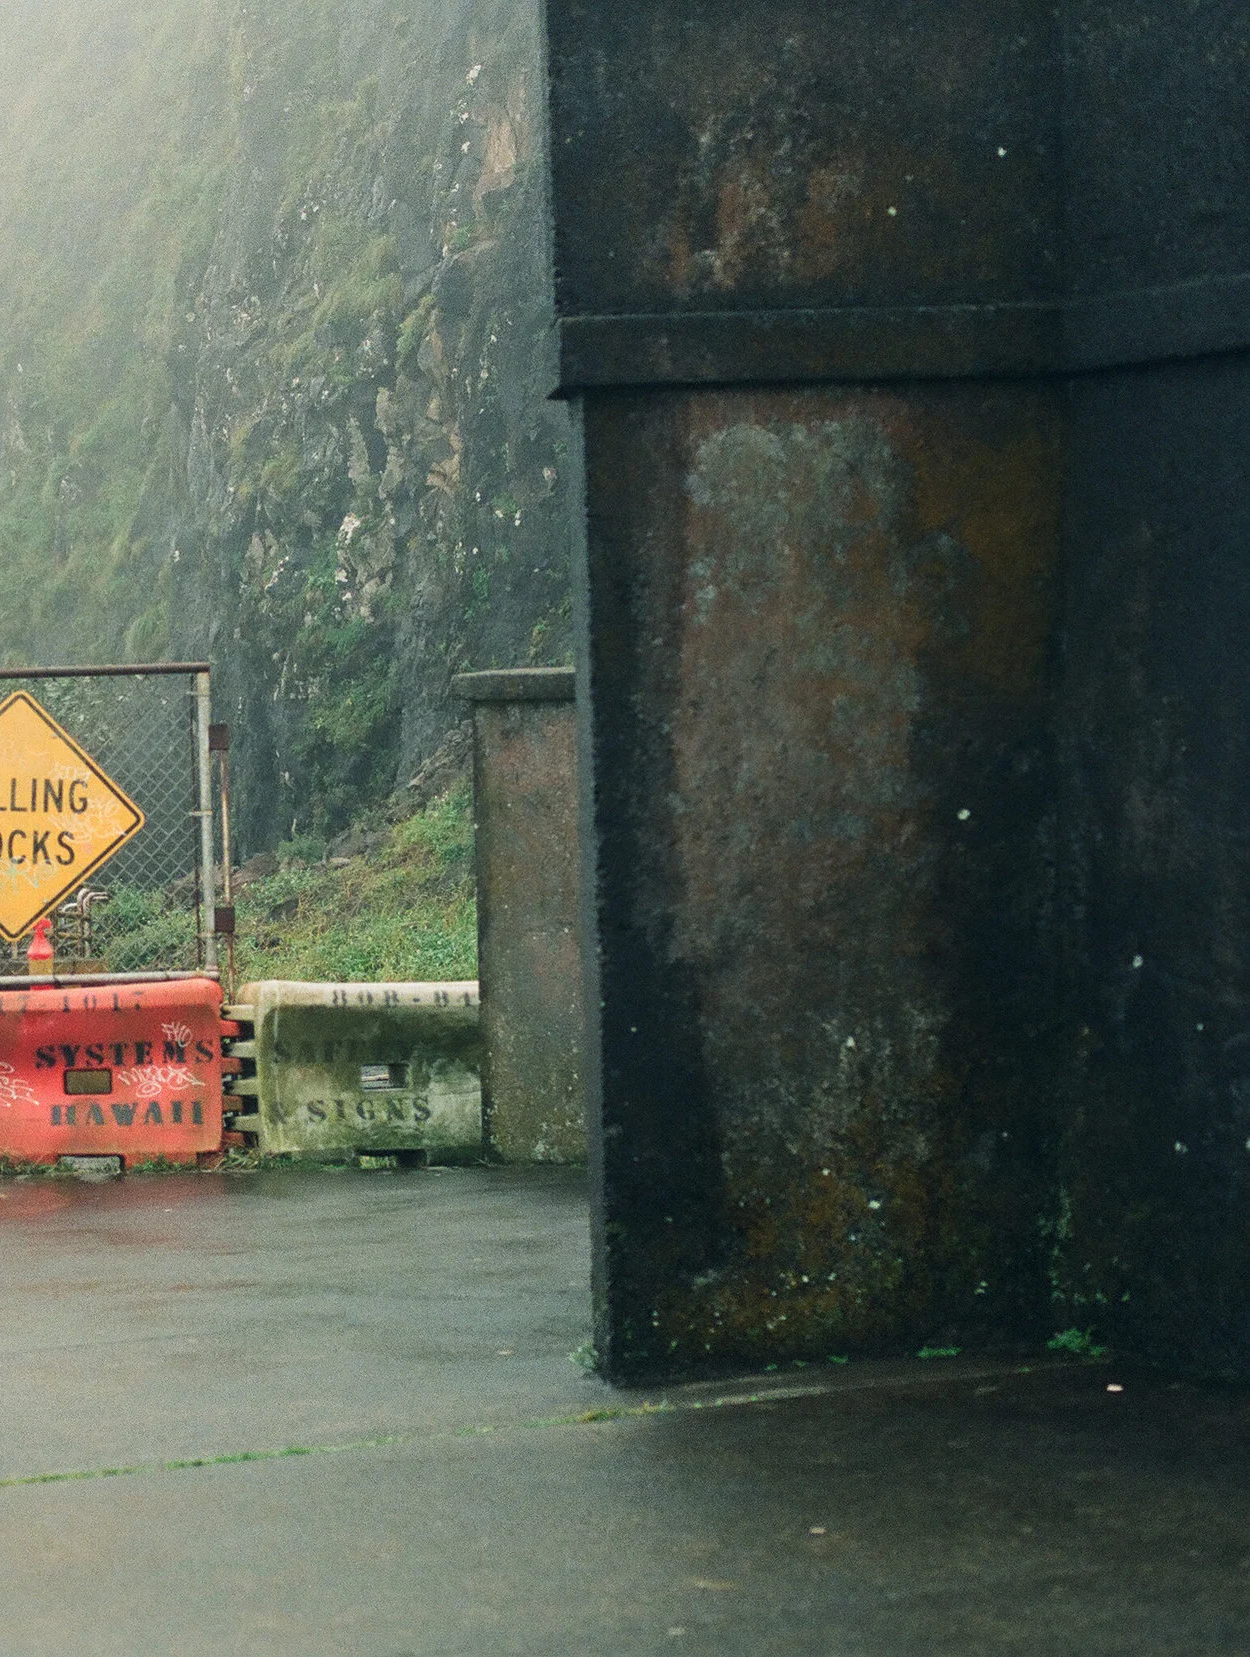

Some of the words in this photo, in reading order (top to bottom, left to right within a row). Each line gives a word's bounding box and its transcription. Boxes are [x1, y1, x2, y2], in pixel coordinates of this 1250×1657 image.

[35, 1039, 215, 1069] SYSTEMS
[50, 1100, 205, 1126] HAWAII
[306, 1098, 432, 1122] SIGNS
